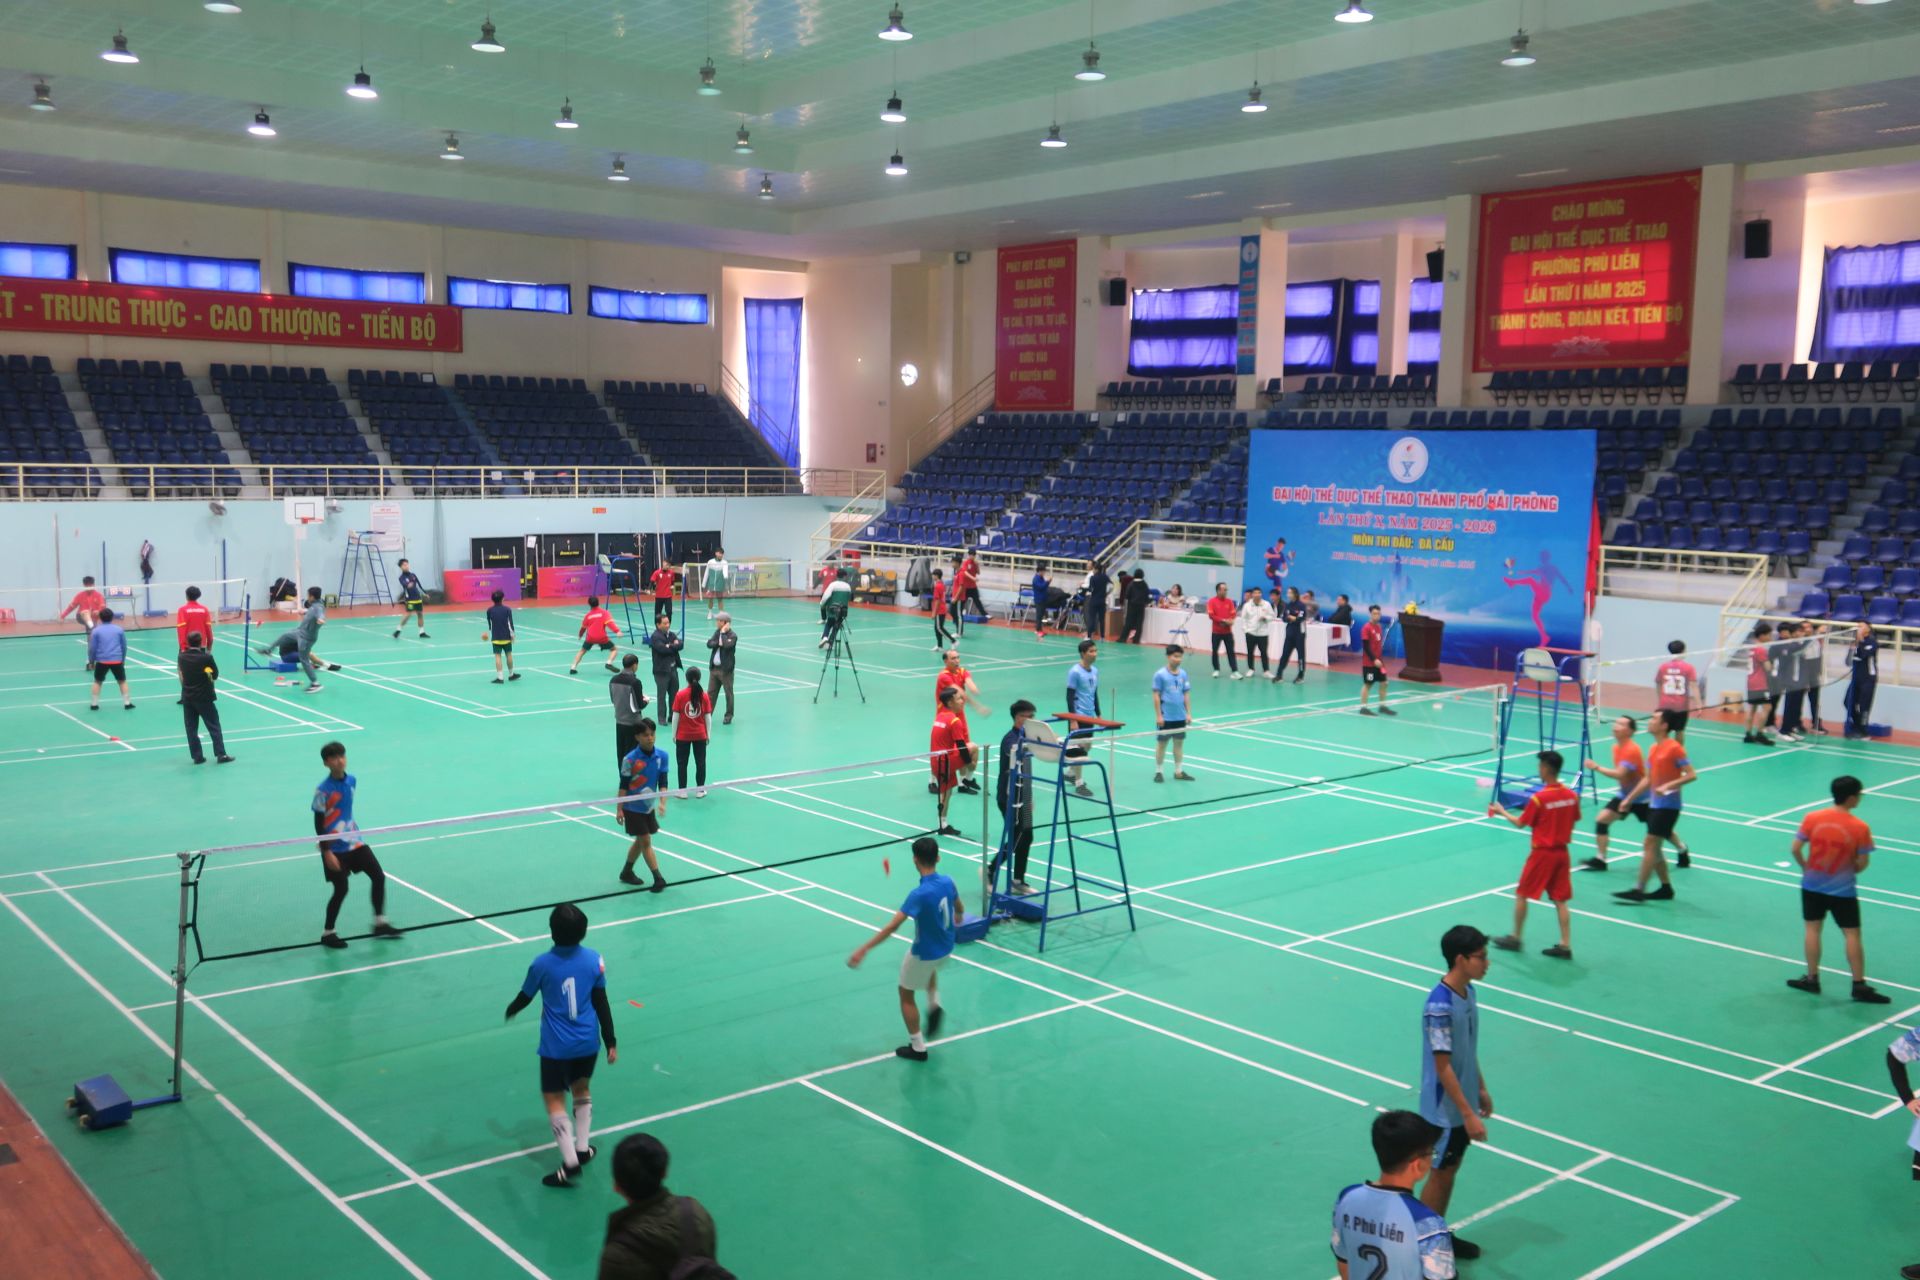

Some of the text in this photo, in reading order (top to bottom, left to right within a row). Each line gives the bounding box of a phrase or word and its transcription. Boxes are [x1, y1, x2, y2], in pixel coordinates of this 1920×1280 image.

[1552, 198, 1624, 221] CHÀO MỪNG
[1511, 219, 1667, 254] ĐẠI HỘI THỂ DỤC THỂ THAO
[1550, 282, 1574, 302] THỨ
[1583, 280, 1612, 300] NĂM
[1615, 280, 1646, 298] 2025
[0, 281, 16, 318] T
[41, 293, 121, 324] TRUNG
[128, 298, 187, 332] THỰC
[209, 304, 252, 332] CAO
[259, 307, 341, 341] THƯỢNG
[361, 307, 405, 340] TIẾN
[411, 312, 436, 346] BỘ
[1490, 311, 1526, 331] THÀNH
[1529, 309, 1565, 329] CÔNG,
[1568, 307, 1601, 327] ĐOÀN
[1632, 304, 1662, 323] TIẾN
[1666, 302, 1683, 325] BỘ
[1273, 483, 1559, 512] ĐẠI HỘI THỂ DỤC THỂ THAO THÀNH PHỐ HẢI PHÒNG
[1318, 507, 1344, 526] LẦN
[1347, 510, 1373, 527] THỨ
[1388, 514, 1418, 530] NĂM
[1421, 518, 1453, 531] 2025
[1463, 519, 1497, 533] 2026
[1353, 533, 1374, 547] MÔN
[1376, 535, 1390, 547] THI
[1419, 536, 1432, 550] ĐÁ
[939, 896, 951, 931] 1
[562, 976, 578, 1021] 1
[1358, 1243, 1389, 1280] 2
